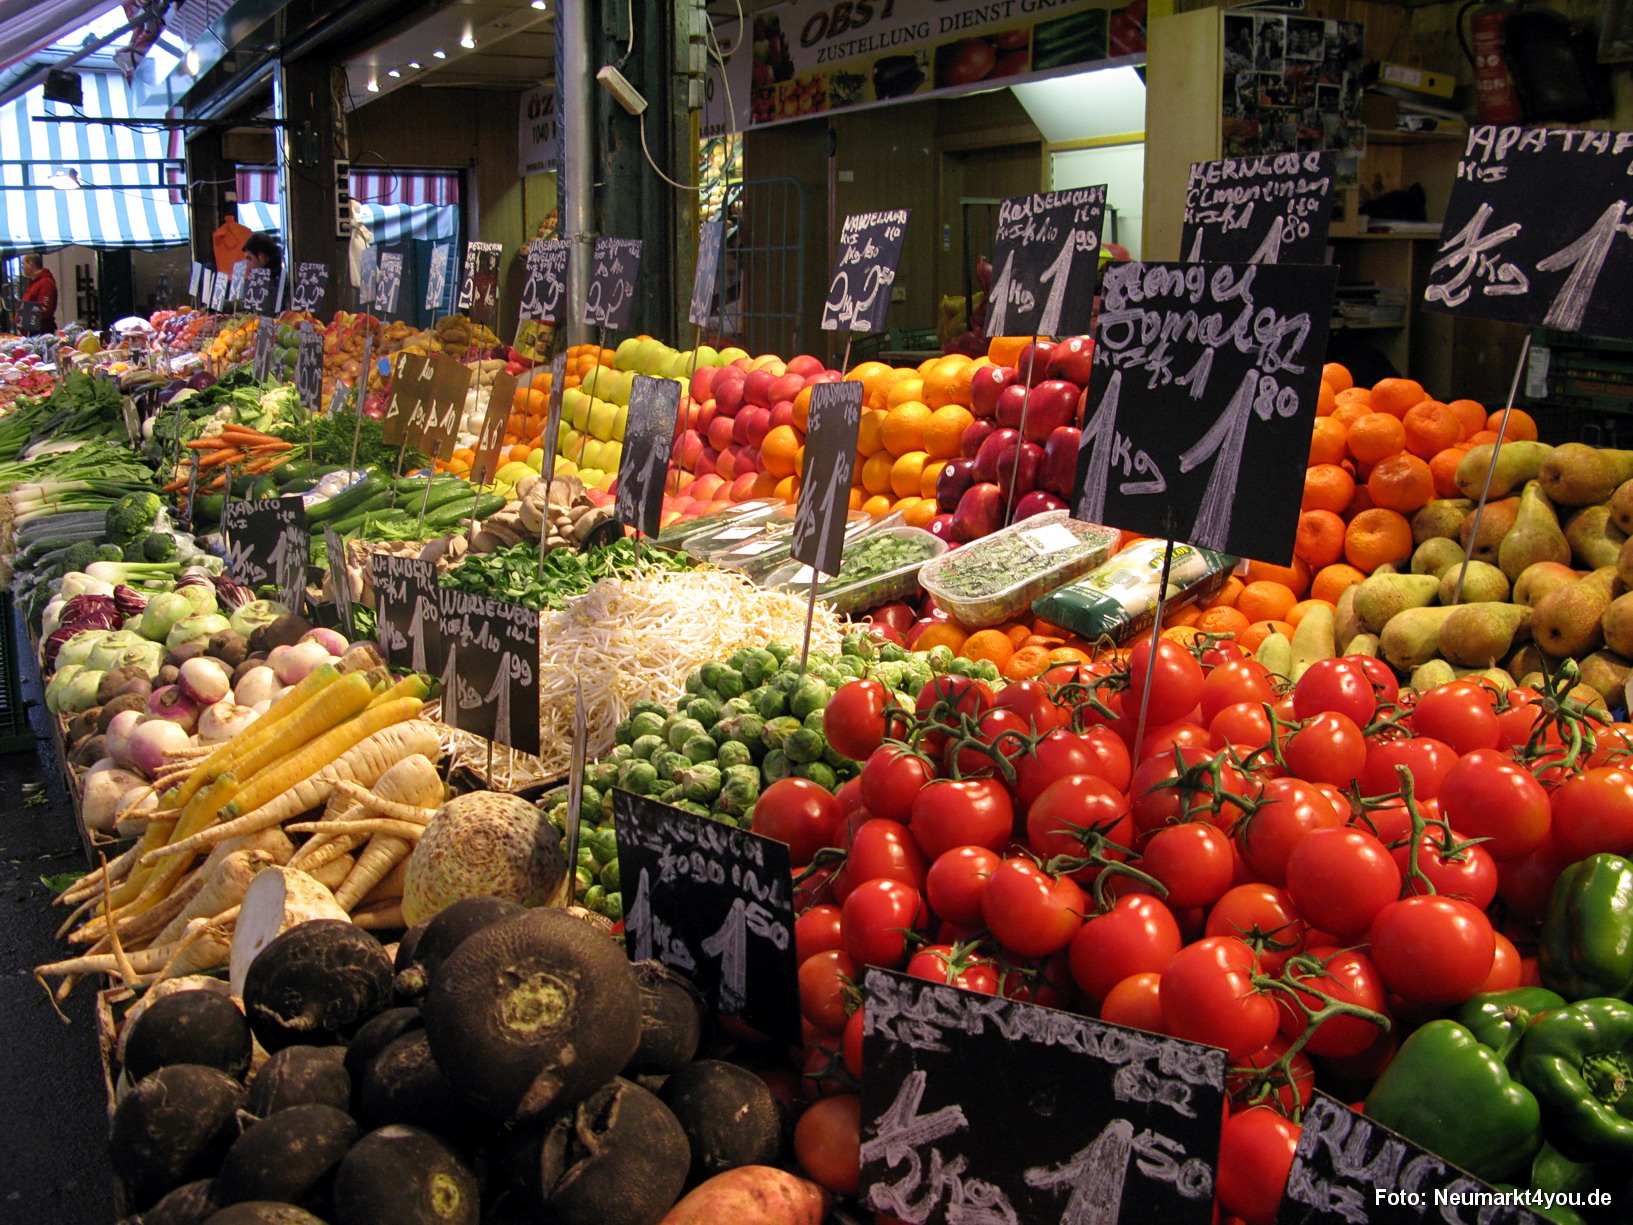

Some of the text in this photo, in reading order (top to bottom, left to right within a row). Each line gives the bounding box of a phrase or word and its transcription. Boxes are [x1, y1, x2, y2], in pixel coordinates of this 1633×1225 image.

[816, 21, 931, 64] ZUSTELLUNG
[938, 1, 1016, 35] DIENST
[226, 499, 281, 518] RADICCO
